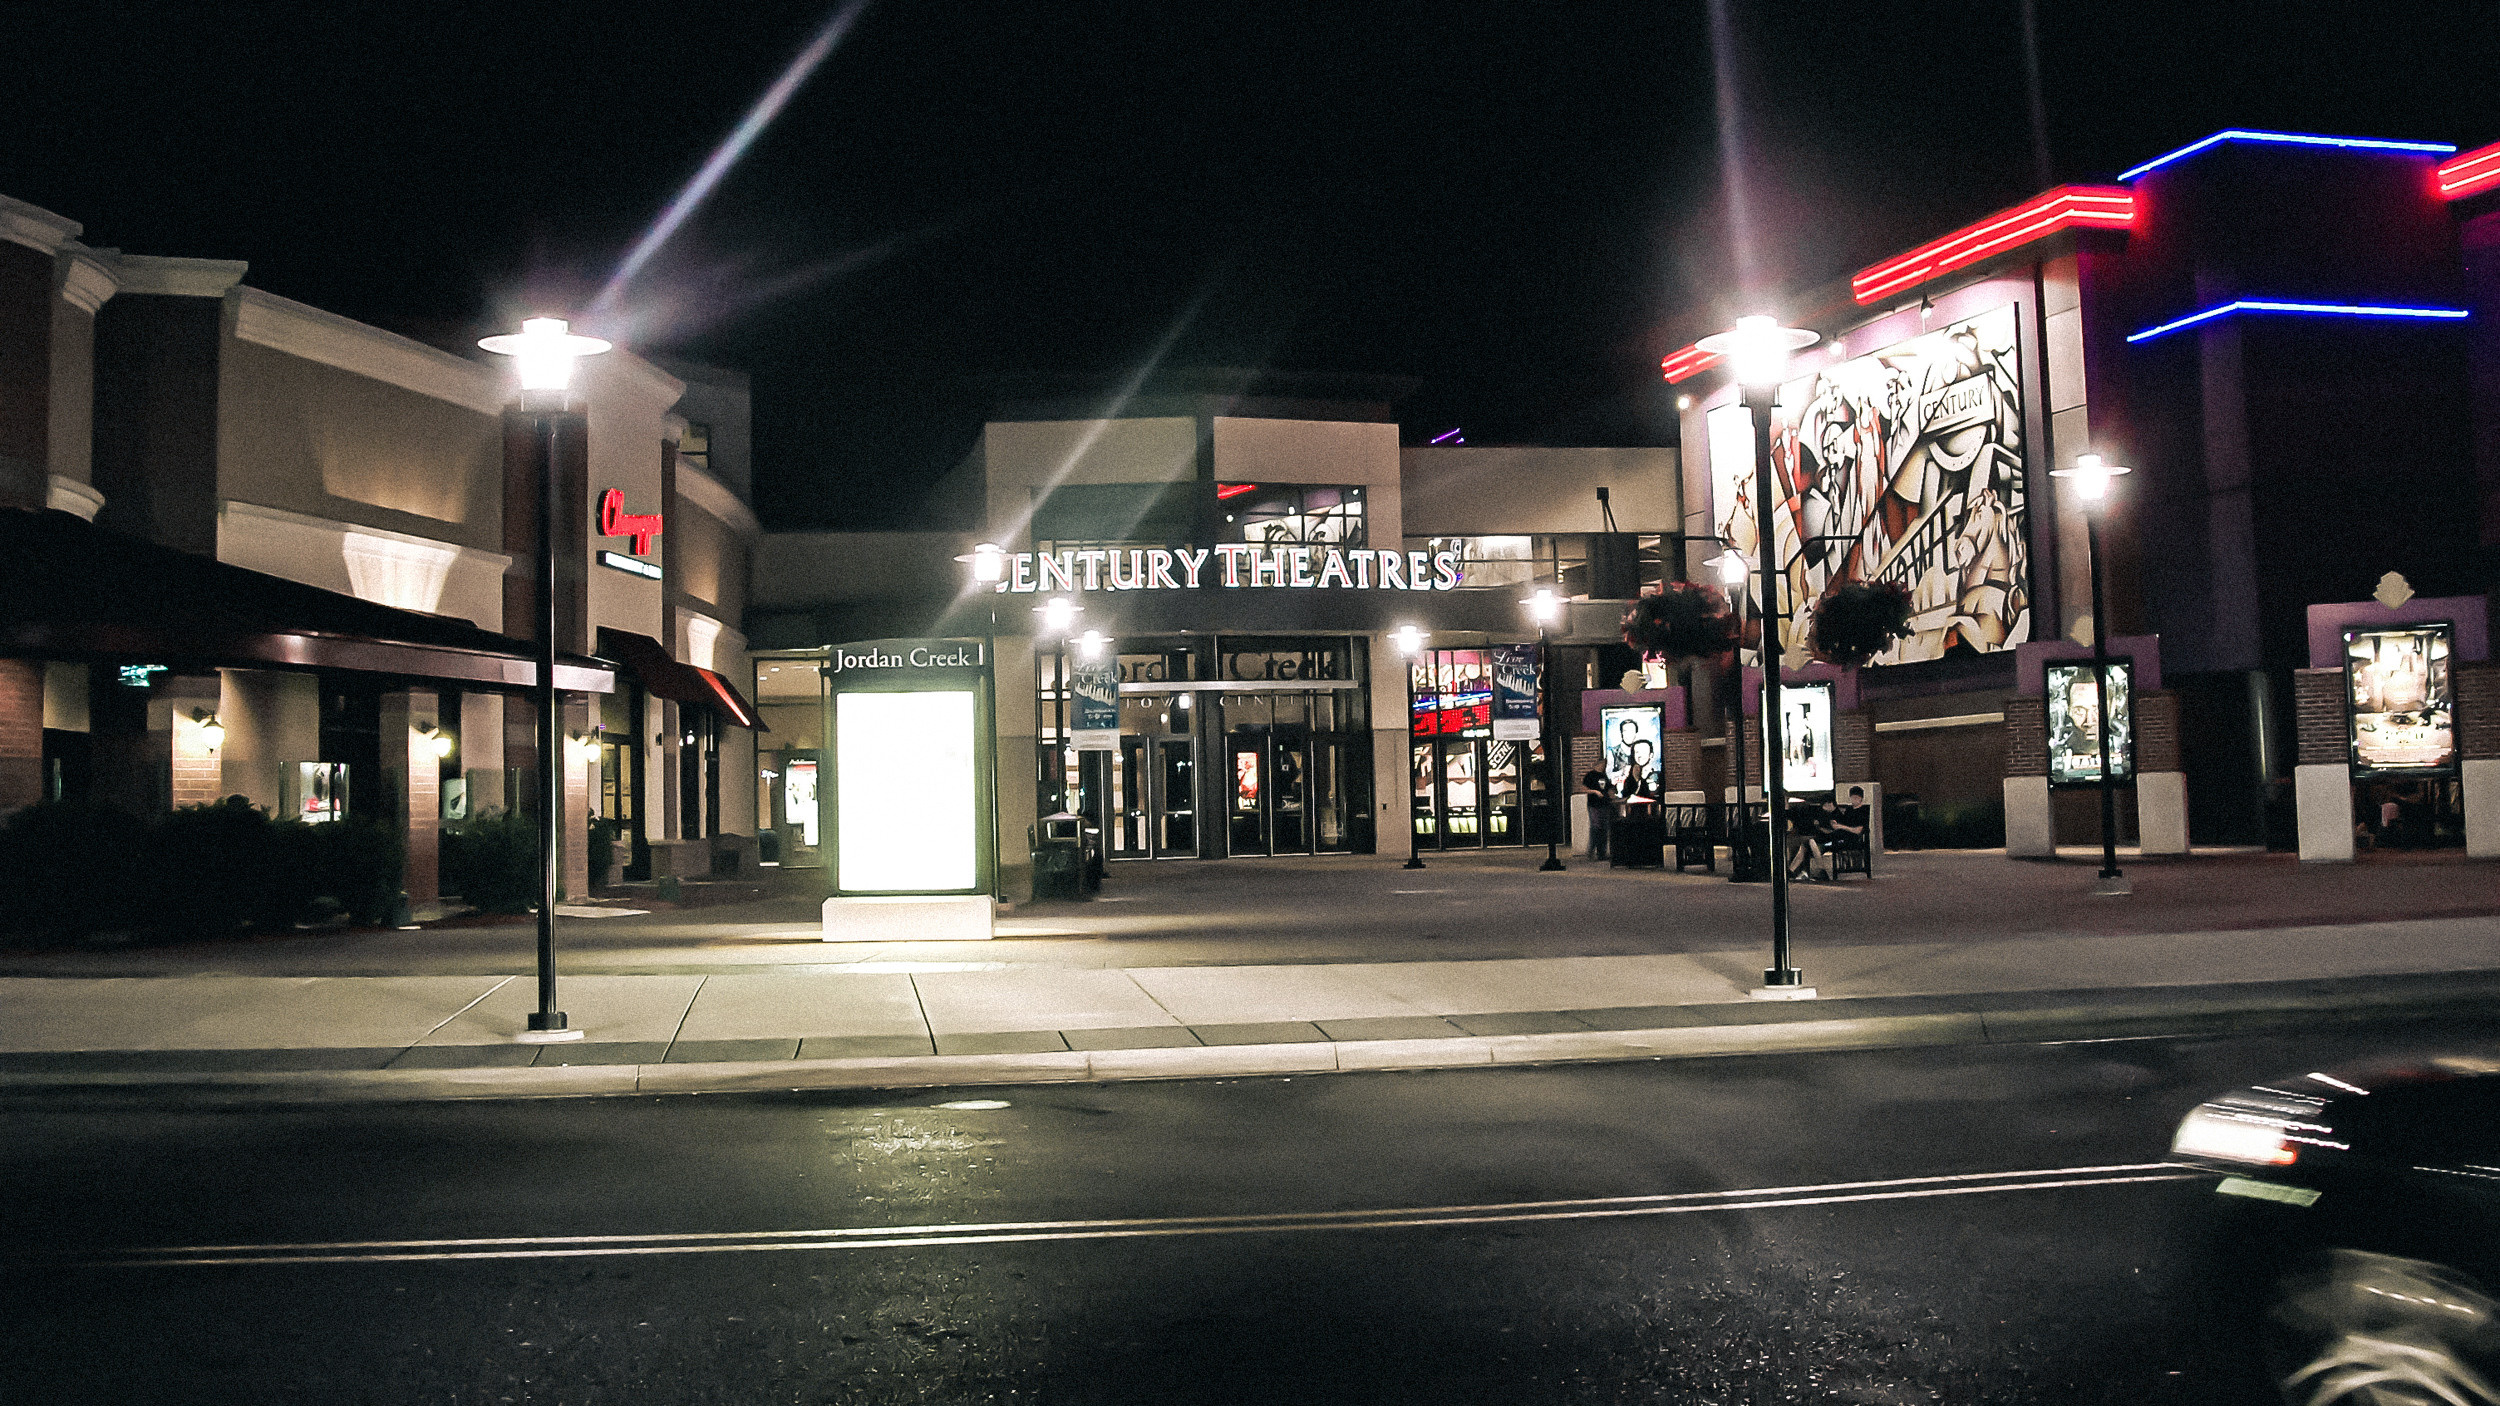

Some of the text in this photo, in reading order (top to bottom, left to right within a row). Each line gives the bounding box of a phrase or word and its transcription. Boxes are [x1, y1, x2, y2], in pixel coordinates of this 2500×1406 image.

[1924, 385, 1984, 421] CENTURY
[996, 543, 1456, 592] ENTURY THEATRES
[834, 647, 970, 673] Jordan Creek
